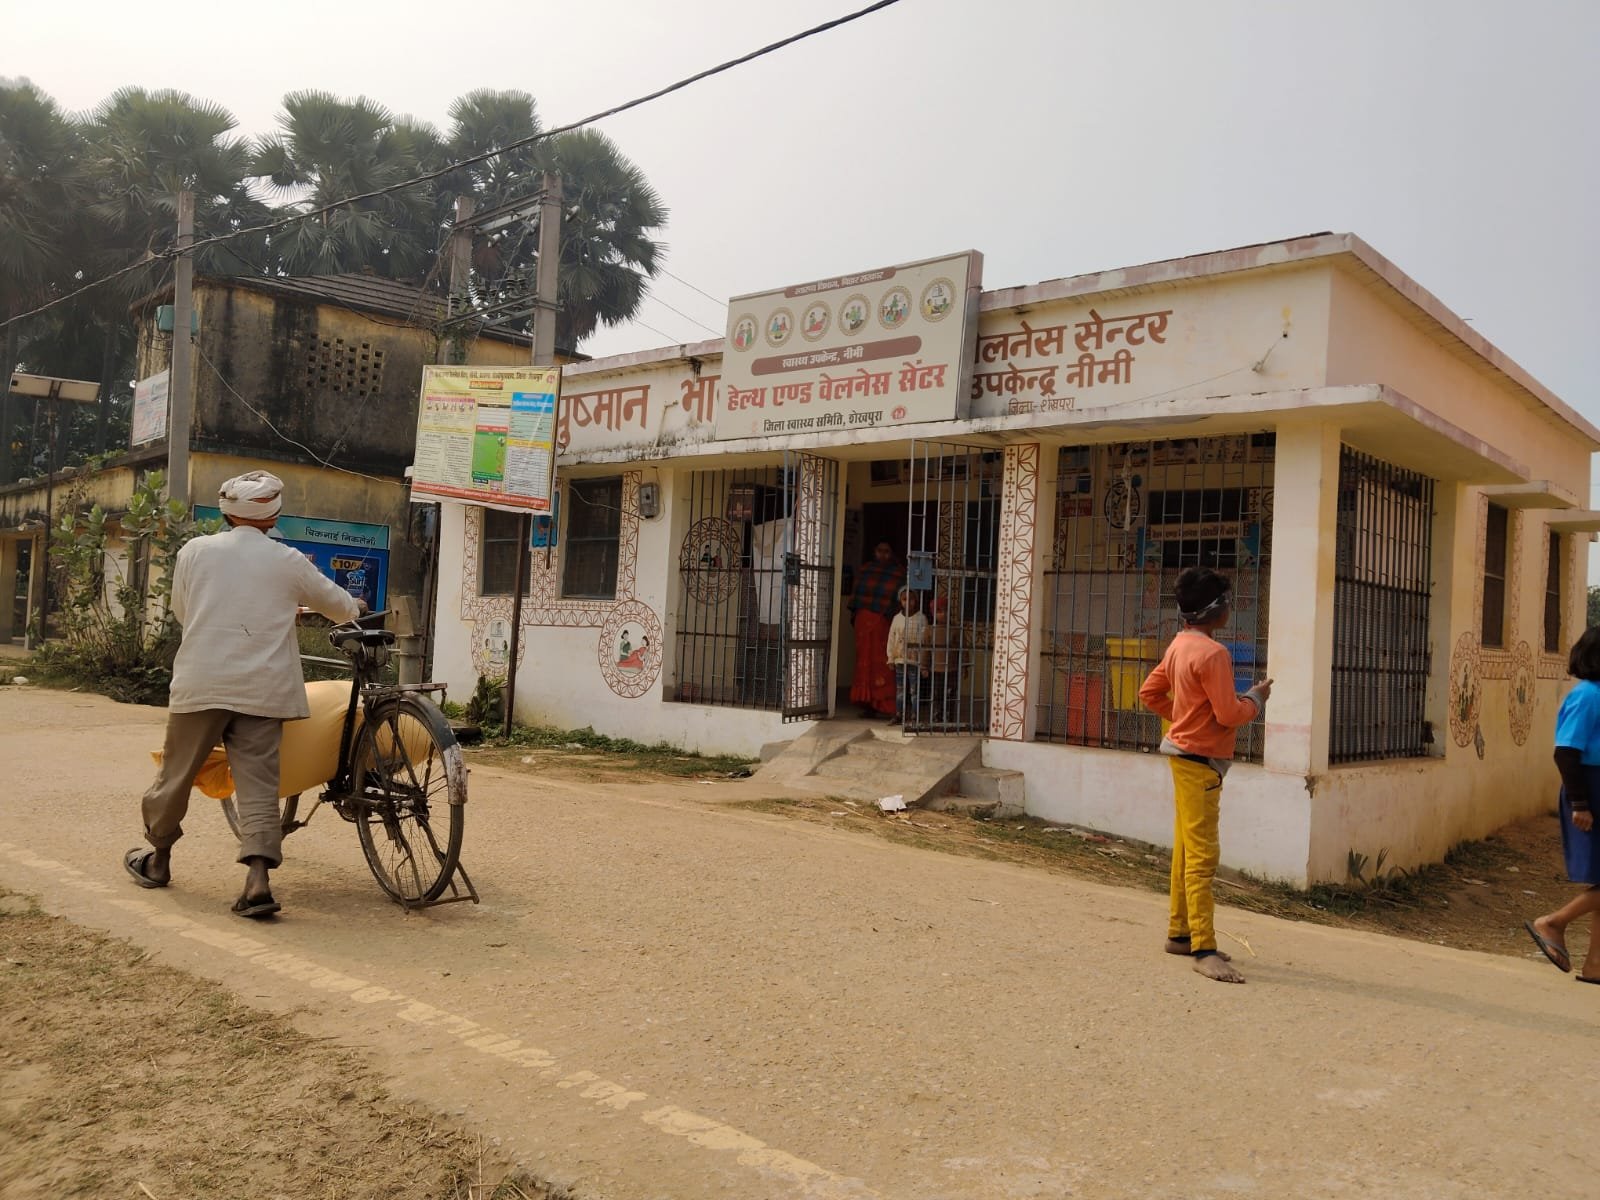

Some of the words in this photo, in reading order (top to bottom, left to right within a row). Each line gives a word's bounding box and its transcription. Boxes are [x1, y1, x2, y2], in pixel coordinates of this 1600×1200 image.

[843, 346, 864, 360] नीमी
[974, 320, 1068, 364] लनेस
[1074, 308, 1174, 352] सेन्टर
[727, 384, 767, 411] हेल्थ
[772, 382, 814, 406] एण्ड
[819, 368, 893, 401] वेलनेस
[898, 359, 949, 393] सेंटर
[971, 362, 1059, 400] उपकेन्द्र
[1066, 349, 1136, 389] नीमी
[763, 419, 785, 432] जिला
[787, 417, 814, 430] स्वास्थ्य
